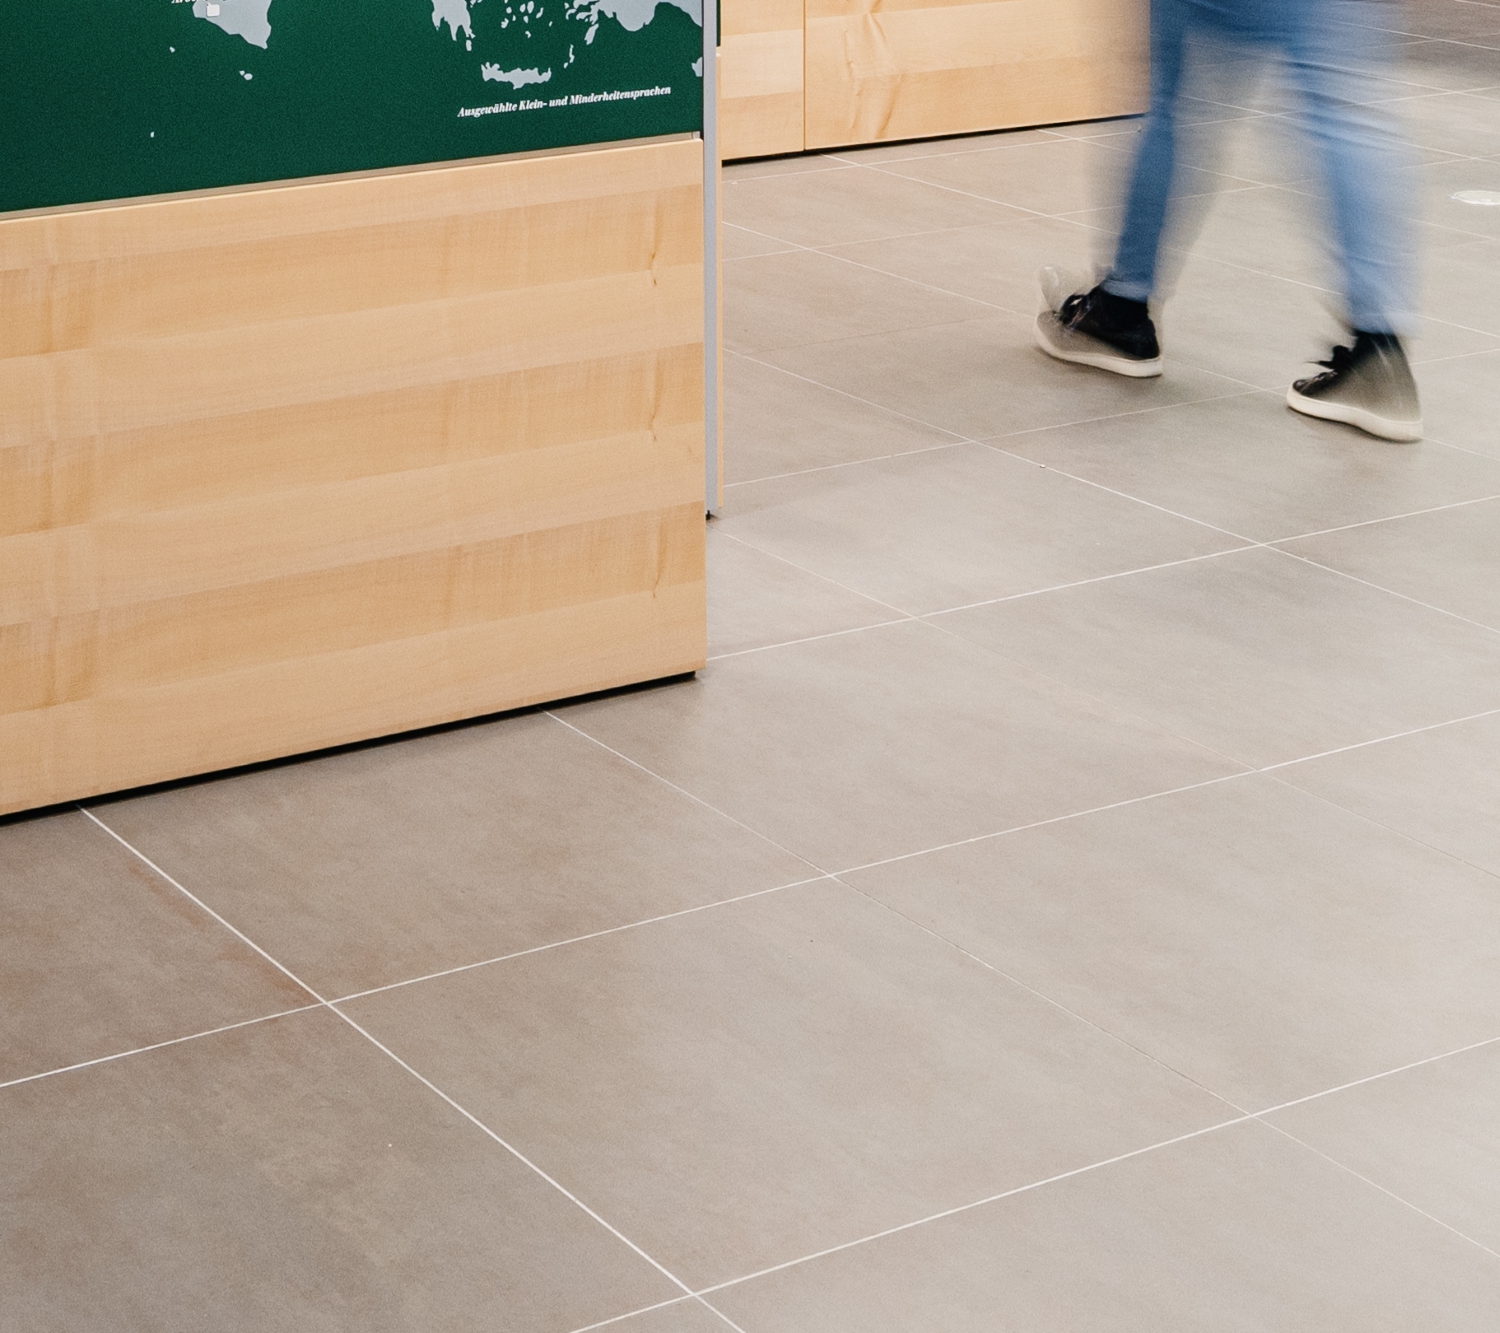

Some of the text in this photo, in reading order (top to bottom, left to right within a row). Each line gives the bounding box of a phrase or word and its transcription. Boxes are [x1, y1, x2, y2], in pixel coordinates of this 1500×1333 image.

[457, 85, 670, 117] Ausgewählte Klein- und Minderheitensprachen
